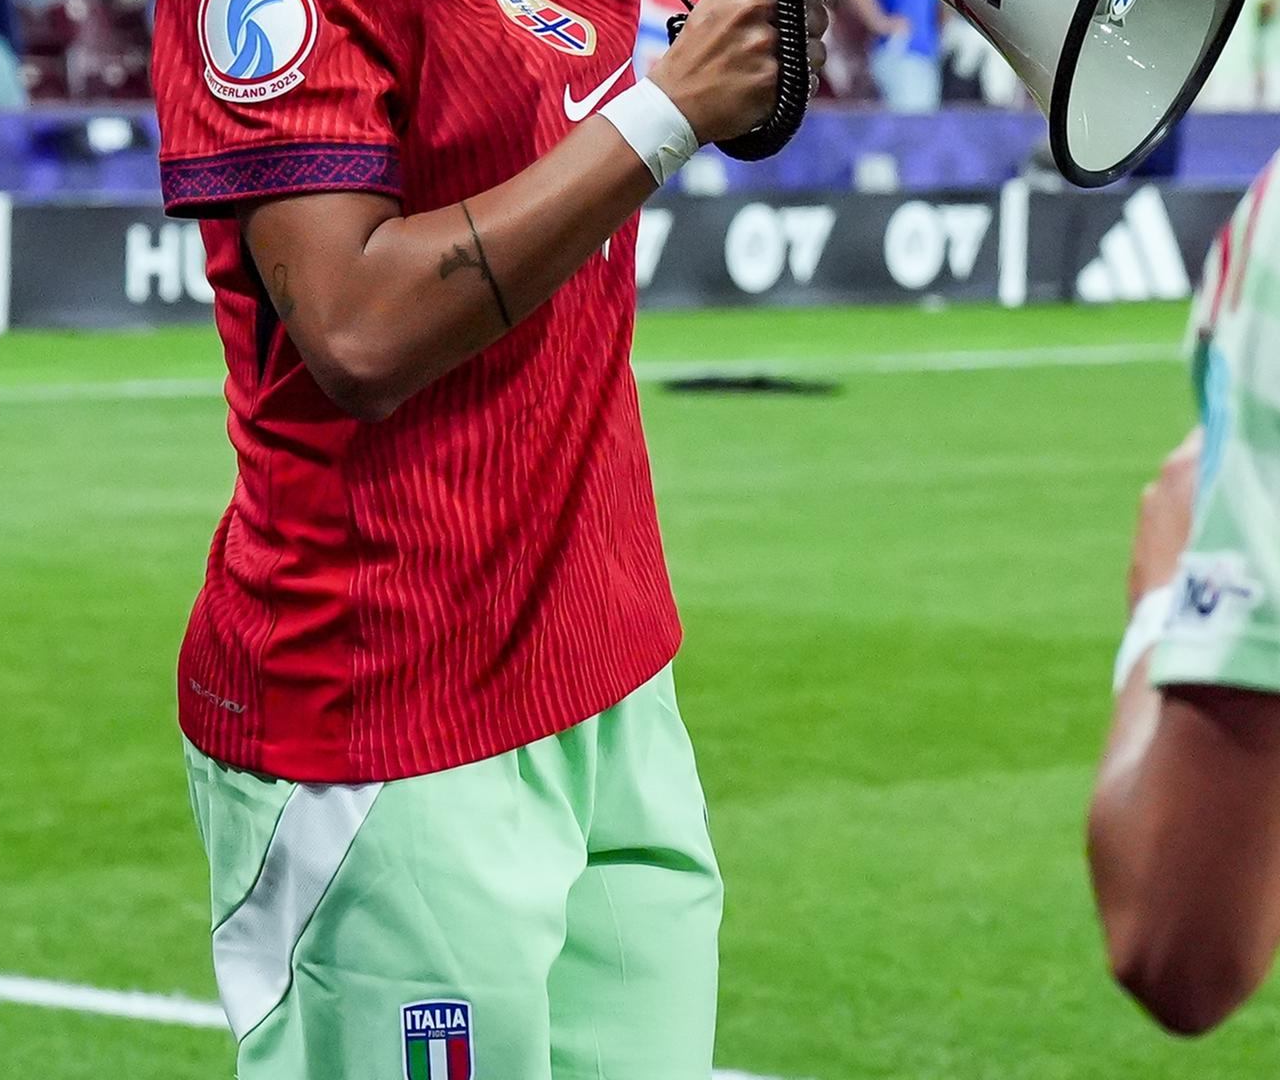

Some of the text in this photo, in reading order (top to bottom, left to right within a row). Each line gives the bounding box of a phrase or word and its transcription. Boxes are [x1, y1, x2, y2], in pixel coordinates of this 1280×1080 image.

[206, 68, 298, 98] SWITZERLAND 2025
[406, 1008, 466, 1030] ITALIA
